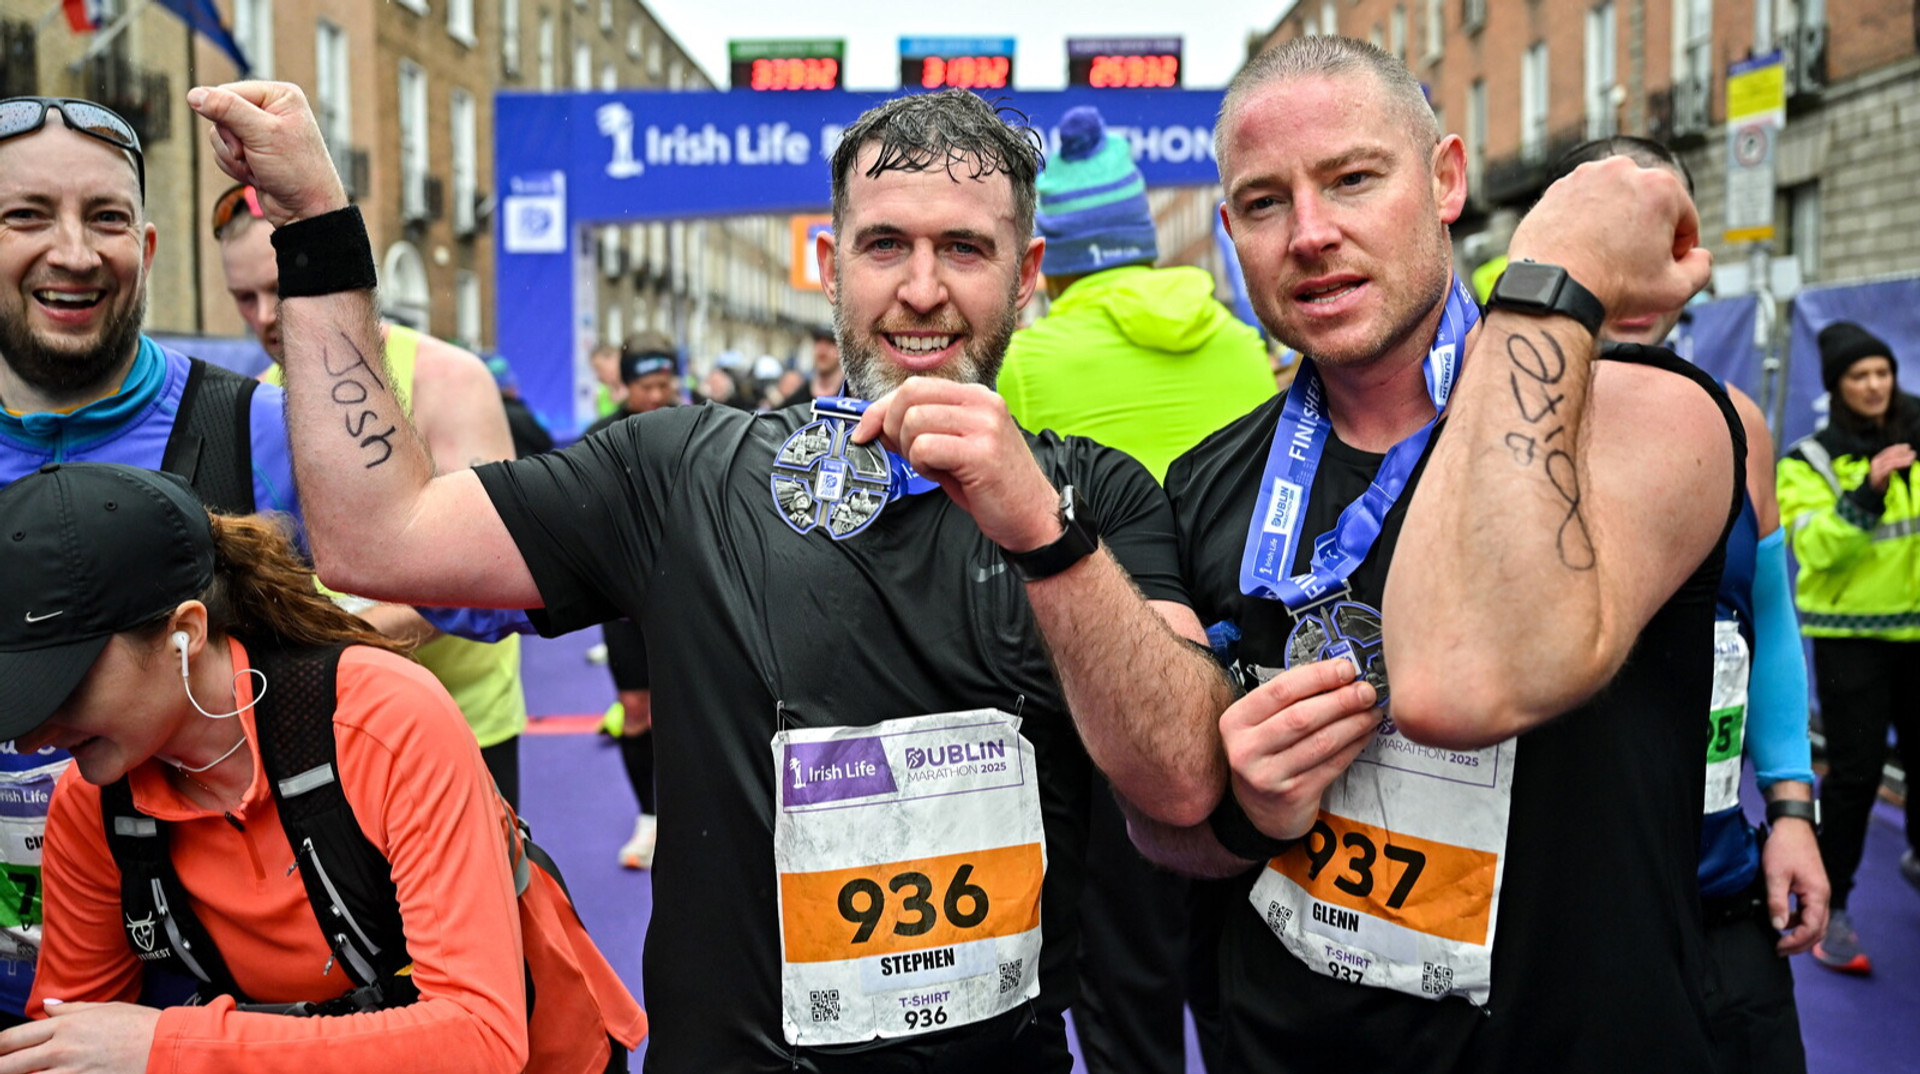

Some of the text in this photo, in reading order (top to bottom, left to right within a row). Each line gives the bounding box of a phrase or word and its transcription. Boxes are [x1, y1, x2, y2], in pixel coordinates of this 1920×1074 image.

[646, 123, 731, 165] Irish
[736, 121, 811, 165] Life
[323, 331, 396, 469] Josh
[1271, 486, 1289, 528] DUBLIN
[905, 739, 1006, 770] DUBLIN
[1376, 737, 1480, 767] MARATHON 2025
[808, 760, 876, 783] Irish Life
[907, 761, 1007, 784] MARATHON 2025
[0, 789, 49, 803] rish Life
[1304, 820, 1426, 909] 937
[837, 864, 989, 944] 936
[1312, 902, 1360, 933] GLENN
[880, 947, 955, 977] STEPHEN
[1325, 945, 1372, 969] T-SHIRT
[1328, 961, 1364, 983] 937
[899, 990, 950, 1008] T-SHIRT
[904, 1005, 948, 1030] 936
